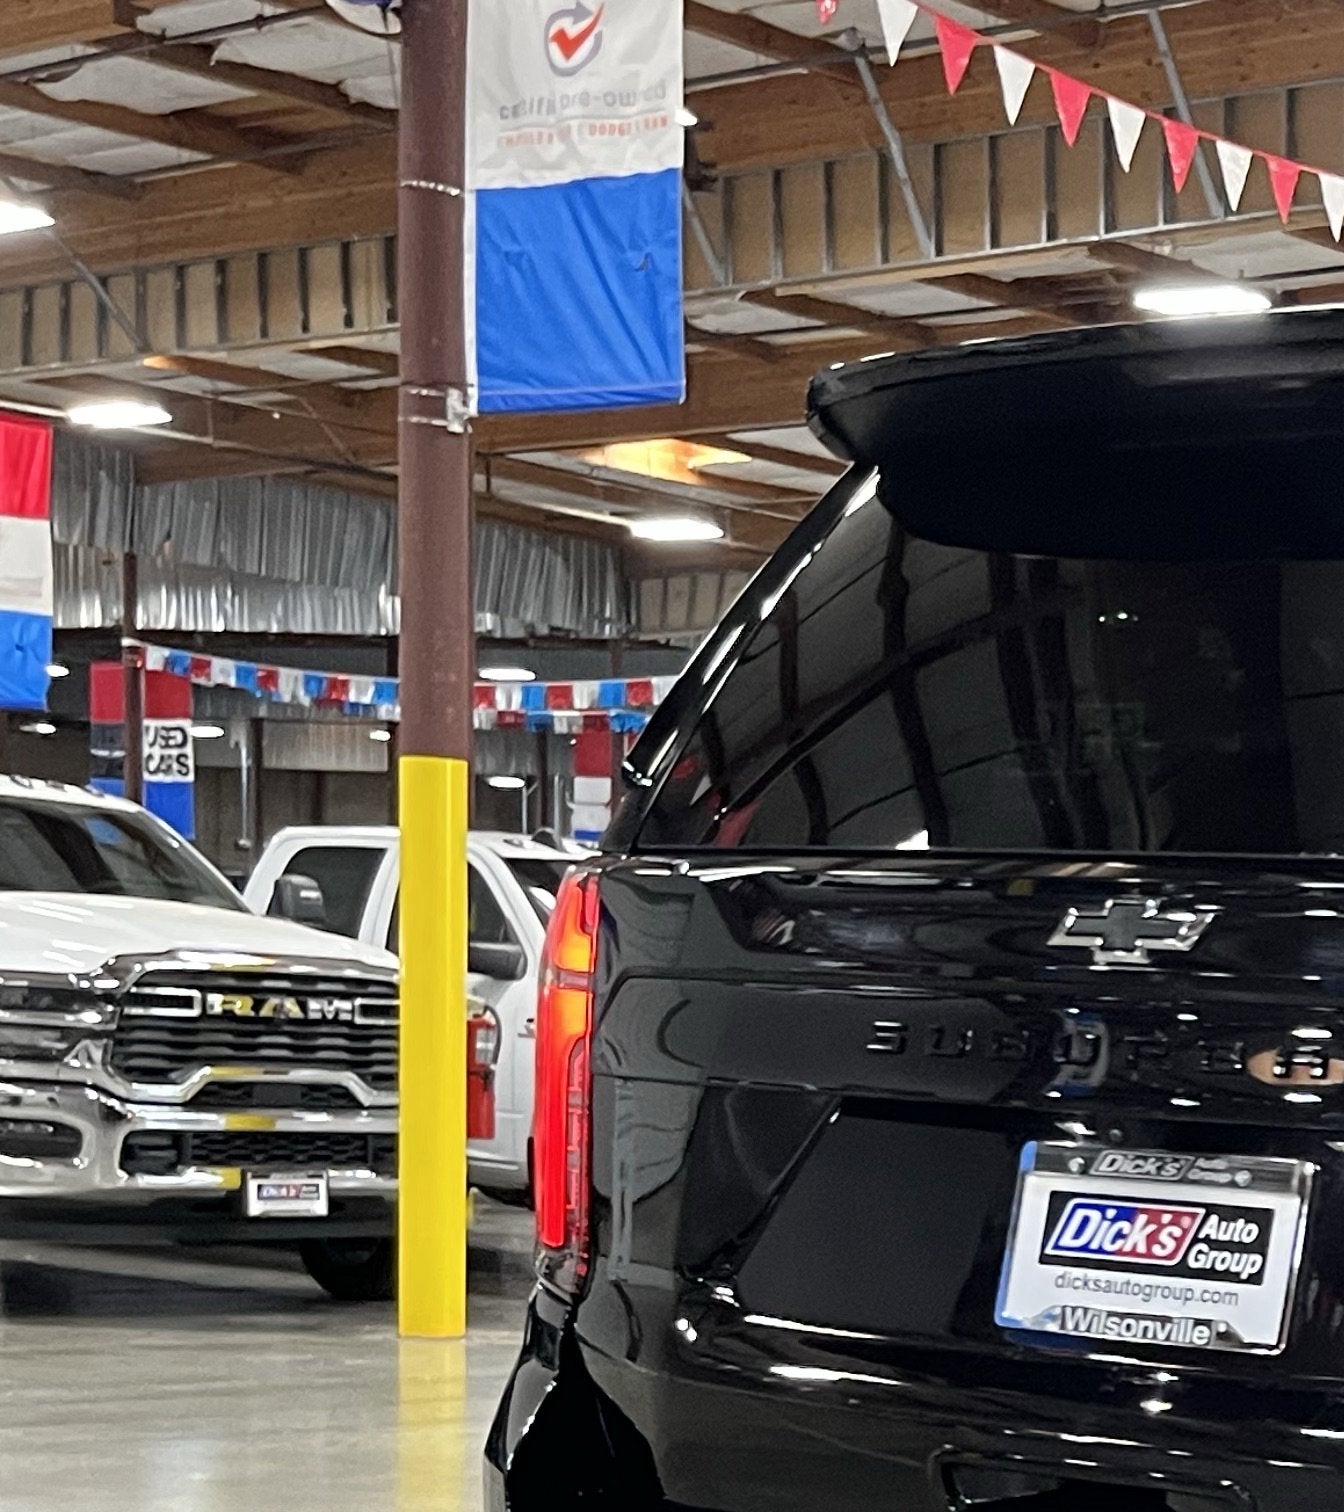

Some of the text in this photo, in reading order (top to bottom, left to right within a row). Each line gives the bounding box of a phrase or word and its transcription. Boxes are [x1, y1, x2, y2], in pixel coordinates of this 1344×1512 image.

[206, 993, 353, 1021] RAM
[1099, 1153, 1182, 1176] Dick's
[1057, 1207, 1183, 1258] Dick's
[1199, 1214, 1259, 1244] Auto
[1187, 1244, 1264, 1280] Group
[1054, 1271, 1240, 1307] dicksautogroup.com
[1063, 1305, 1212, 1346] Wilsonville
